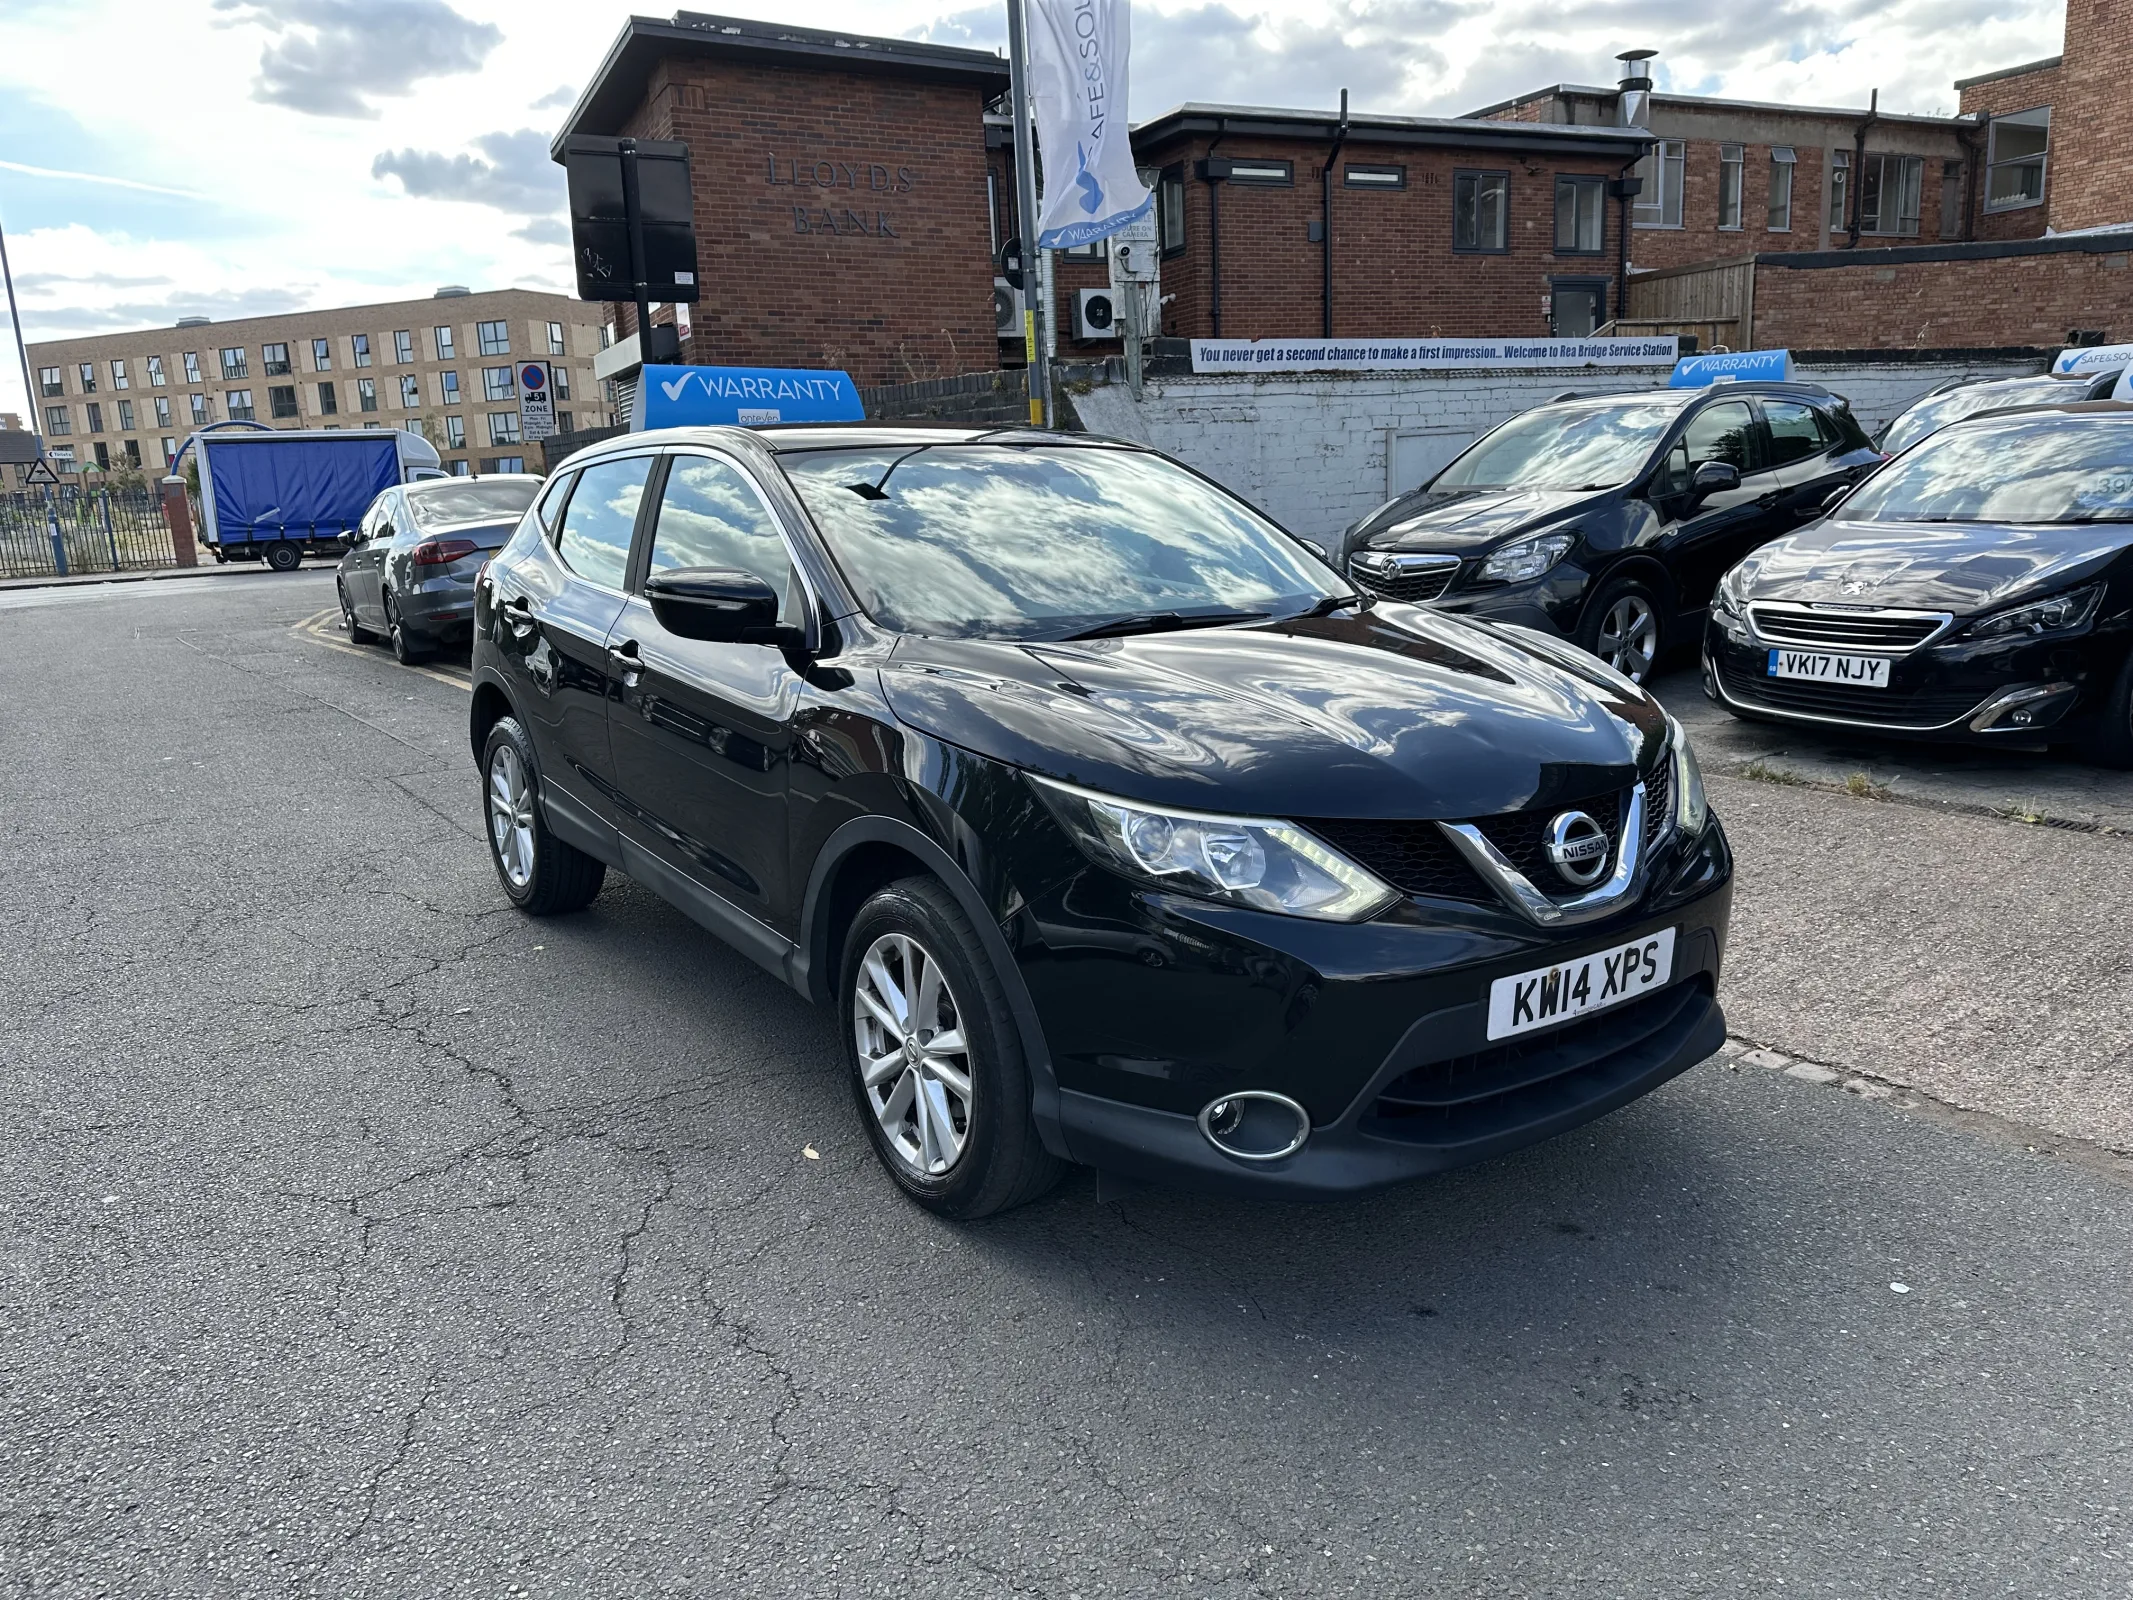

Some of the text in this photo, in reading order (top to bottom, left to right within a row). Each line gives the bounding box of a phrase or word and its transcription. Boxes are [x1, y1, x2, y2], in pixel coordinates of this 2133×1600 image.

[767, 156, 913, 192] LLOYDS
[793, 206, 900, 238] BANK
[1200, 343, 1672, 363] You never get a second chance to make a first impression... Welcome to Rea Bridge Service Station
[1701, 355, 1779, 372] WARRANTY
[698, 376, 841, 400] WARRANTY
[1787, 653, 1880, 681] VK17 NJY
[1563, 839, 1608, 859] NISSAN
[1512, 940, 1659, 1027] KW14 XPS
